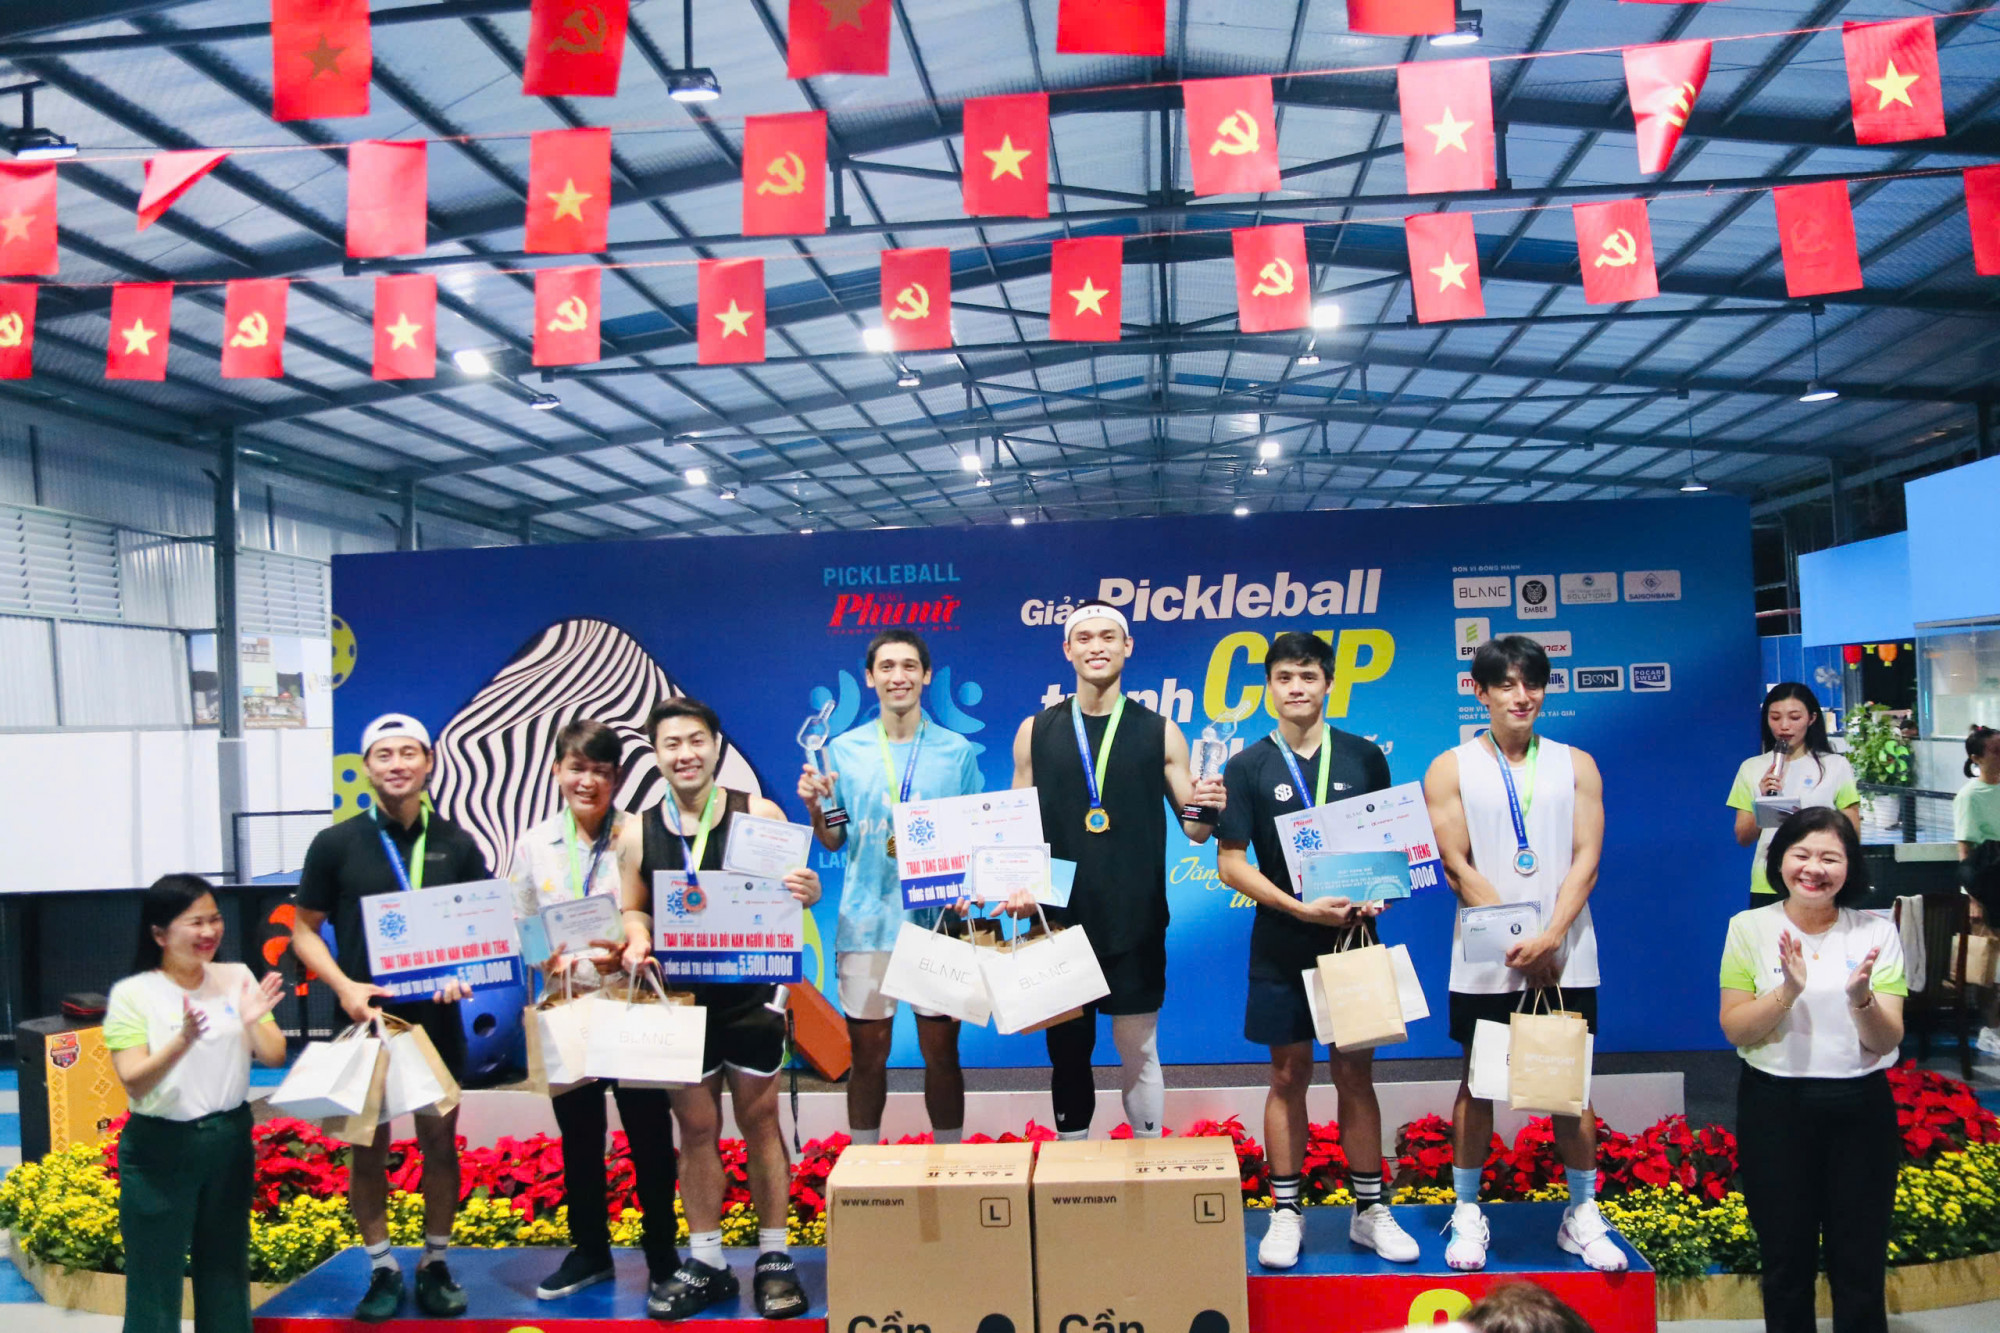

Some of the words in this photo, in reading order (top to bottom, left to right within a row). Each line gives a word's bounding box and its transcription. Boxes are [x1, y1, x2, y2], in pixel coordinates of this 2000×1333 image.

[824, 563, 961, 586] PICKLEBALL
[1021, 595, 1085, 627] Giả
[1098, 568, 1382, 622] Pickleball
[1459, 586, 1507, 598] BLANC
[1203, 628, 1395, 723] CP
[738, 954, 793, 976] 5.500.000đ
[918, 957, 973, 985] BLANC
[1018, 961, 1073, 990] BLANC
[619, 1031, 675, 1046] BLANC
[841, 1197, 904, 1206] www.mia.vn
[1052, 1194, 1117, 1205] www.mia.vn
[1204, 1200, 1216, 1216] L
[990, 1205, 1001, 1221] L
